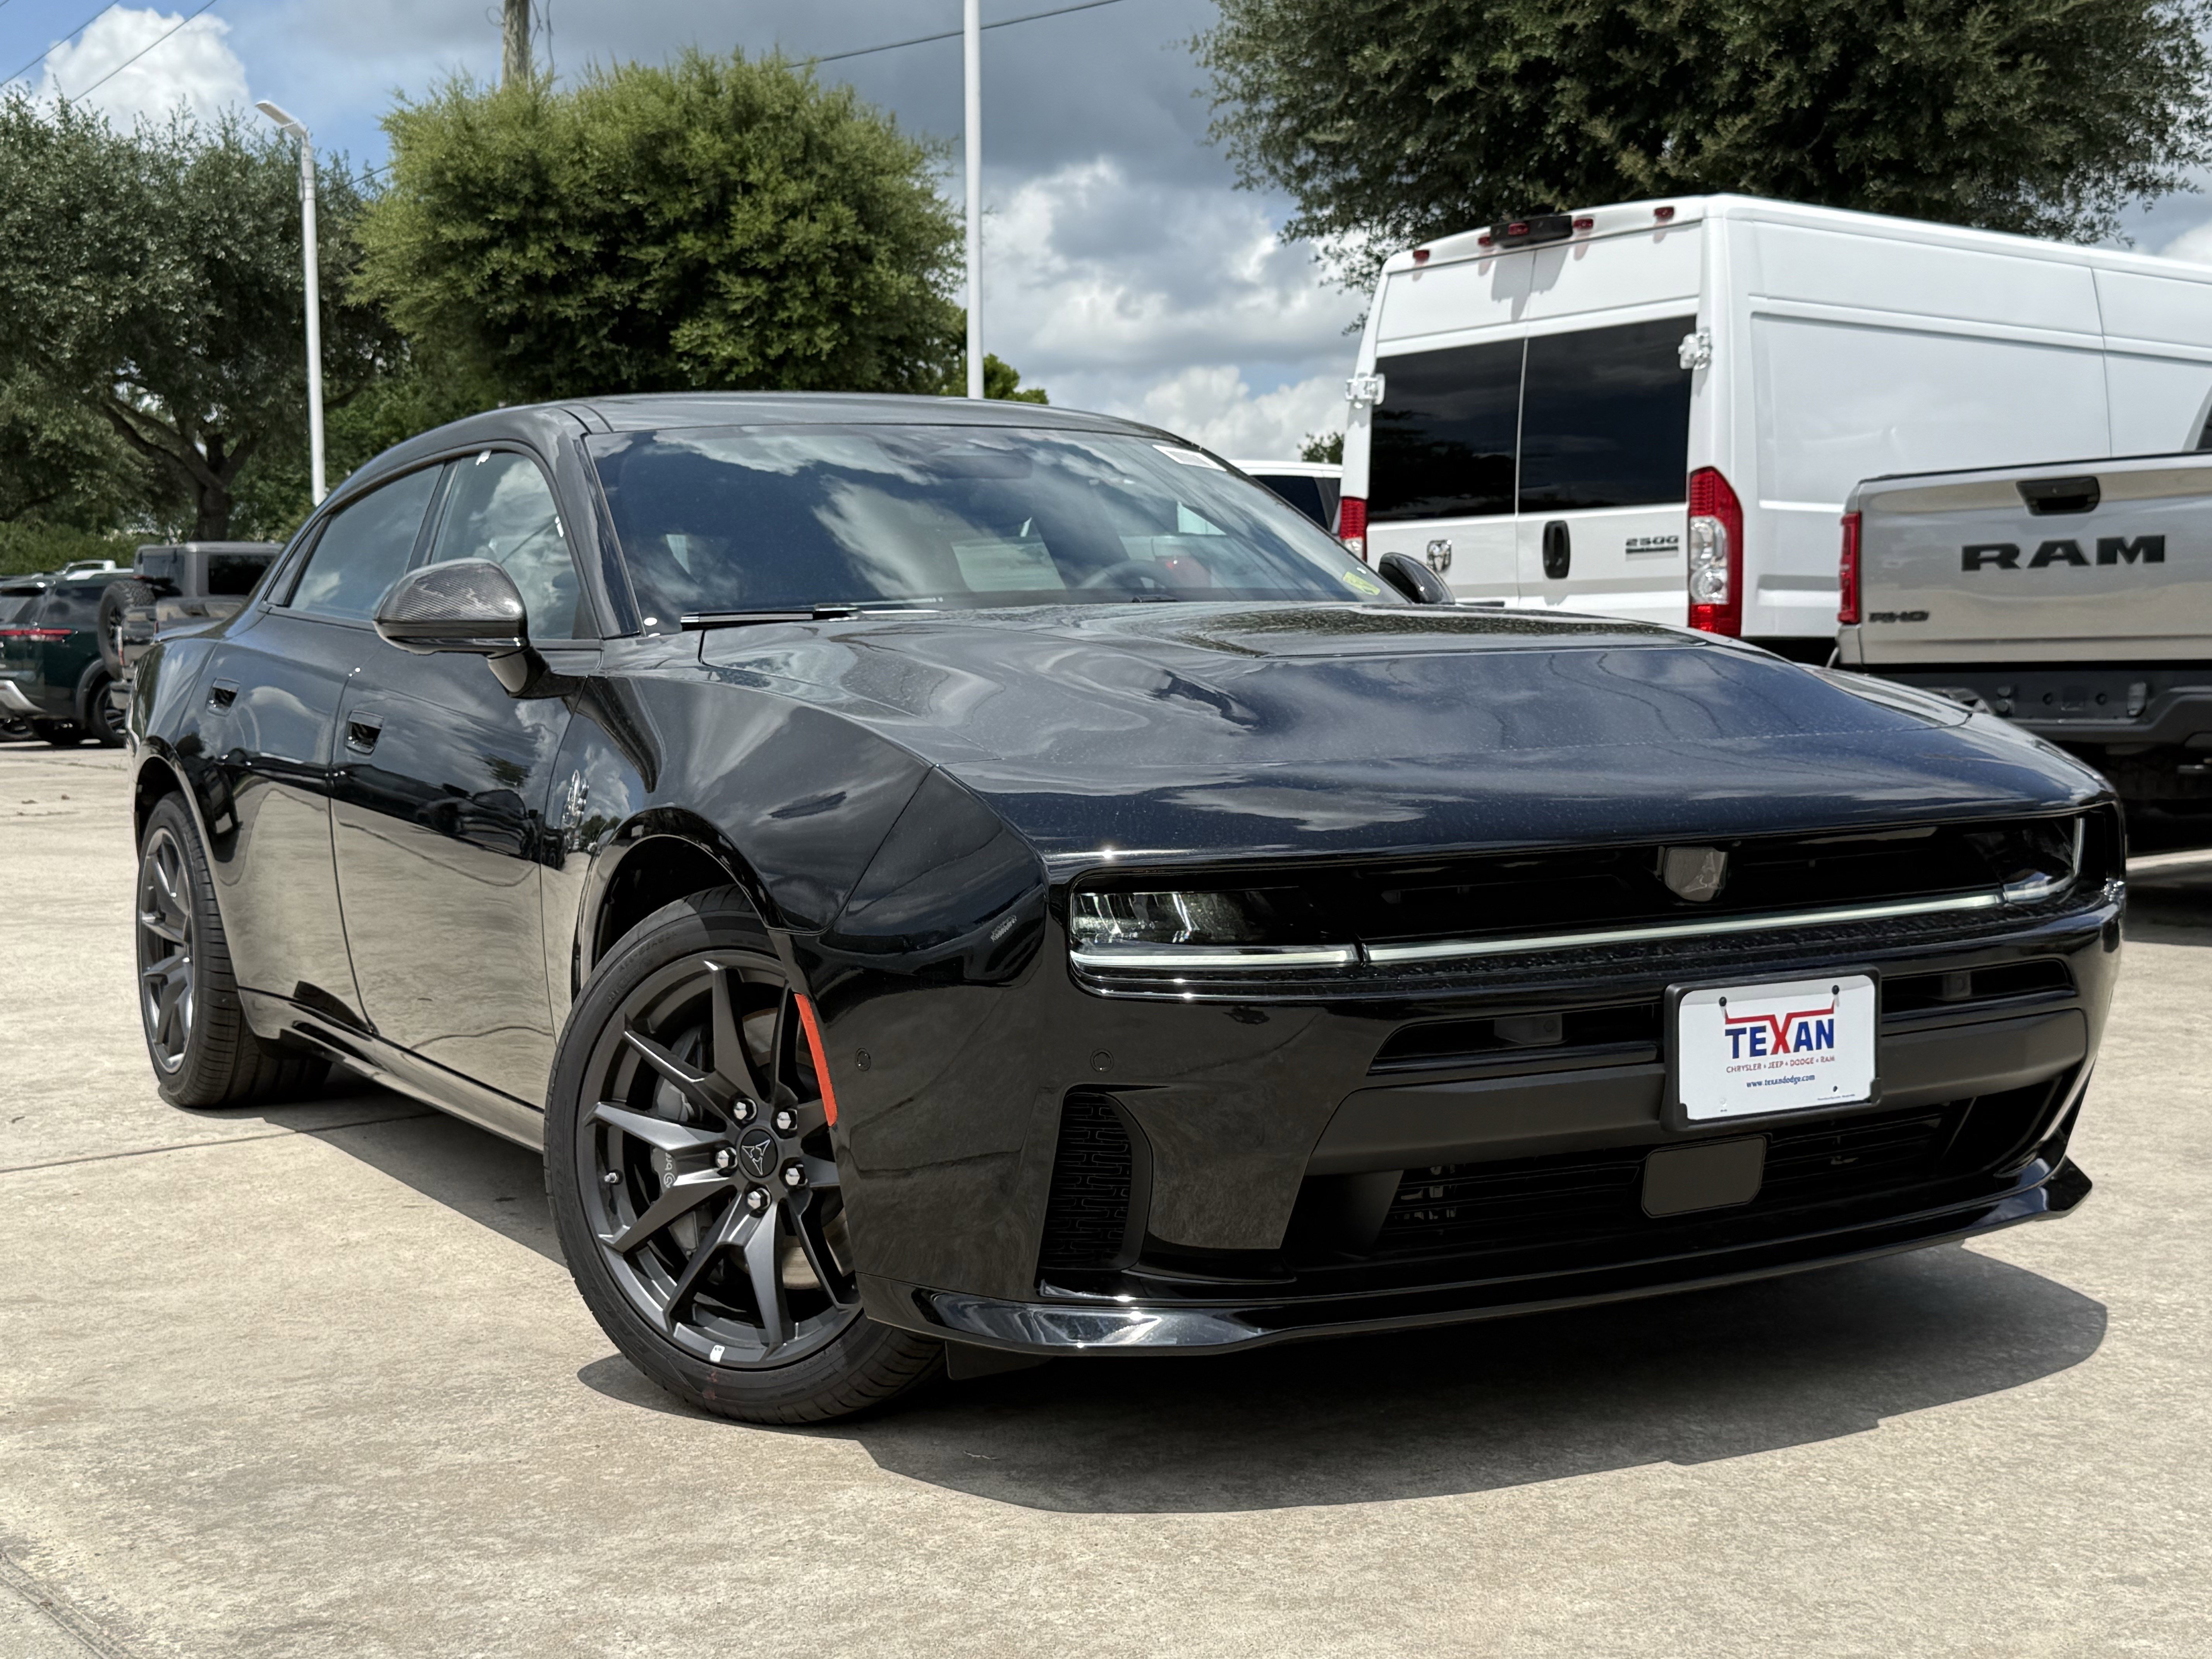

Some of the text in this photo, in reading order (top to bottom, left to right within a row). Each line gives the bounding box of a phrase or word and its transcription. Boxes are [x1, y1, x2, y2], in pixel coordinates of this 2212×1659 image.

[1626, 535, 1679, 546] 2500
[1961, 534, 2166, 572] RAM
[1725, 1012, 1835, 1059] TEXAN
[1726, 1055, 1835, 1073] CHRYSLER JEEP DODGE RAM
